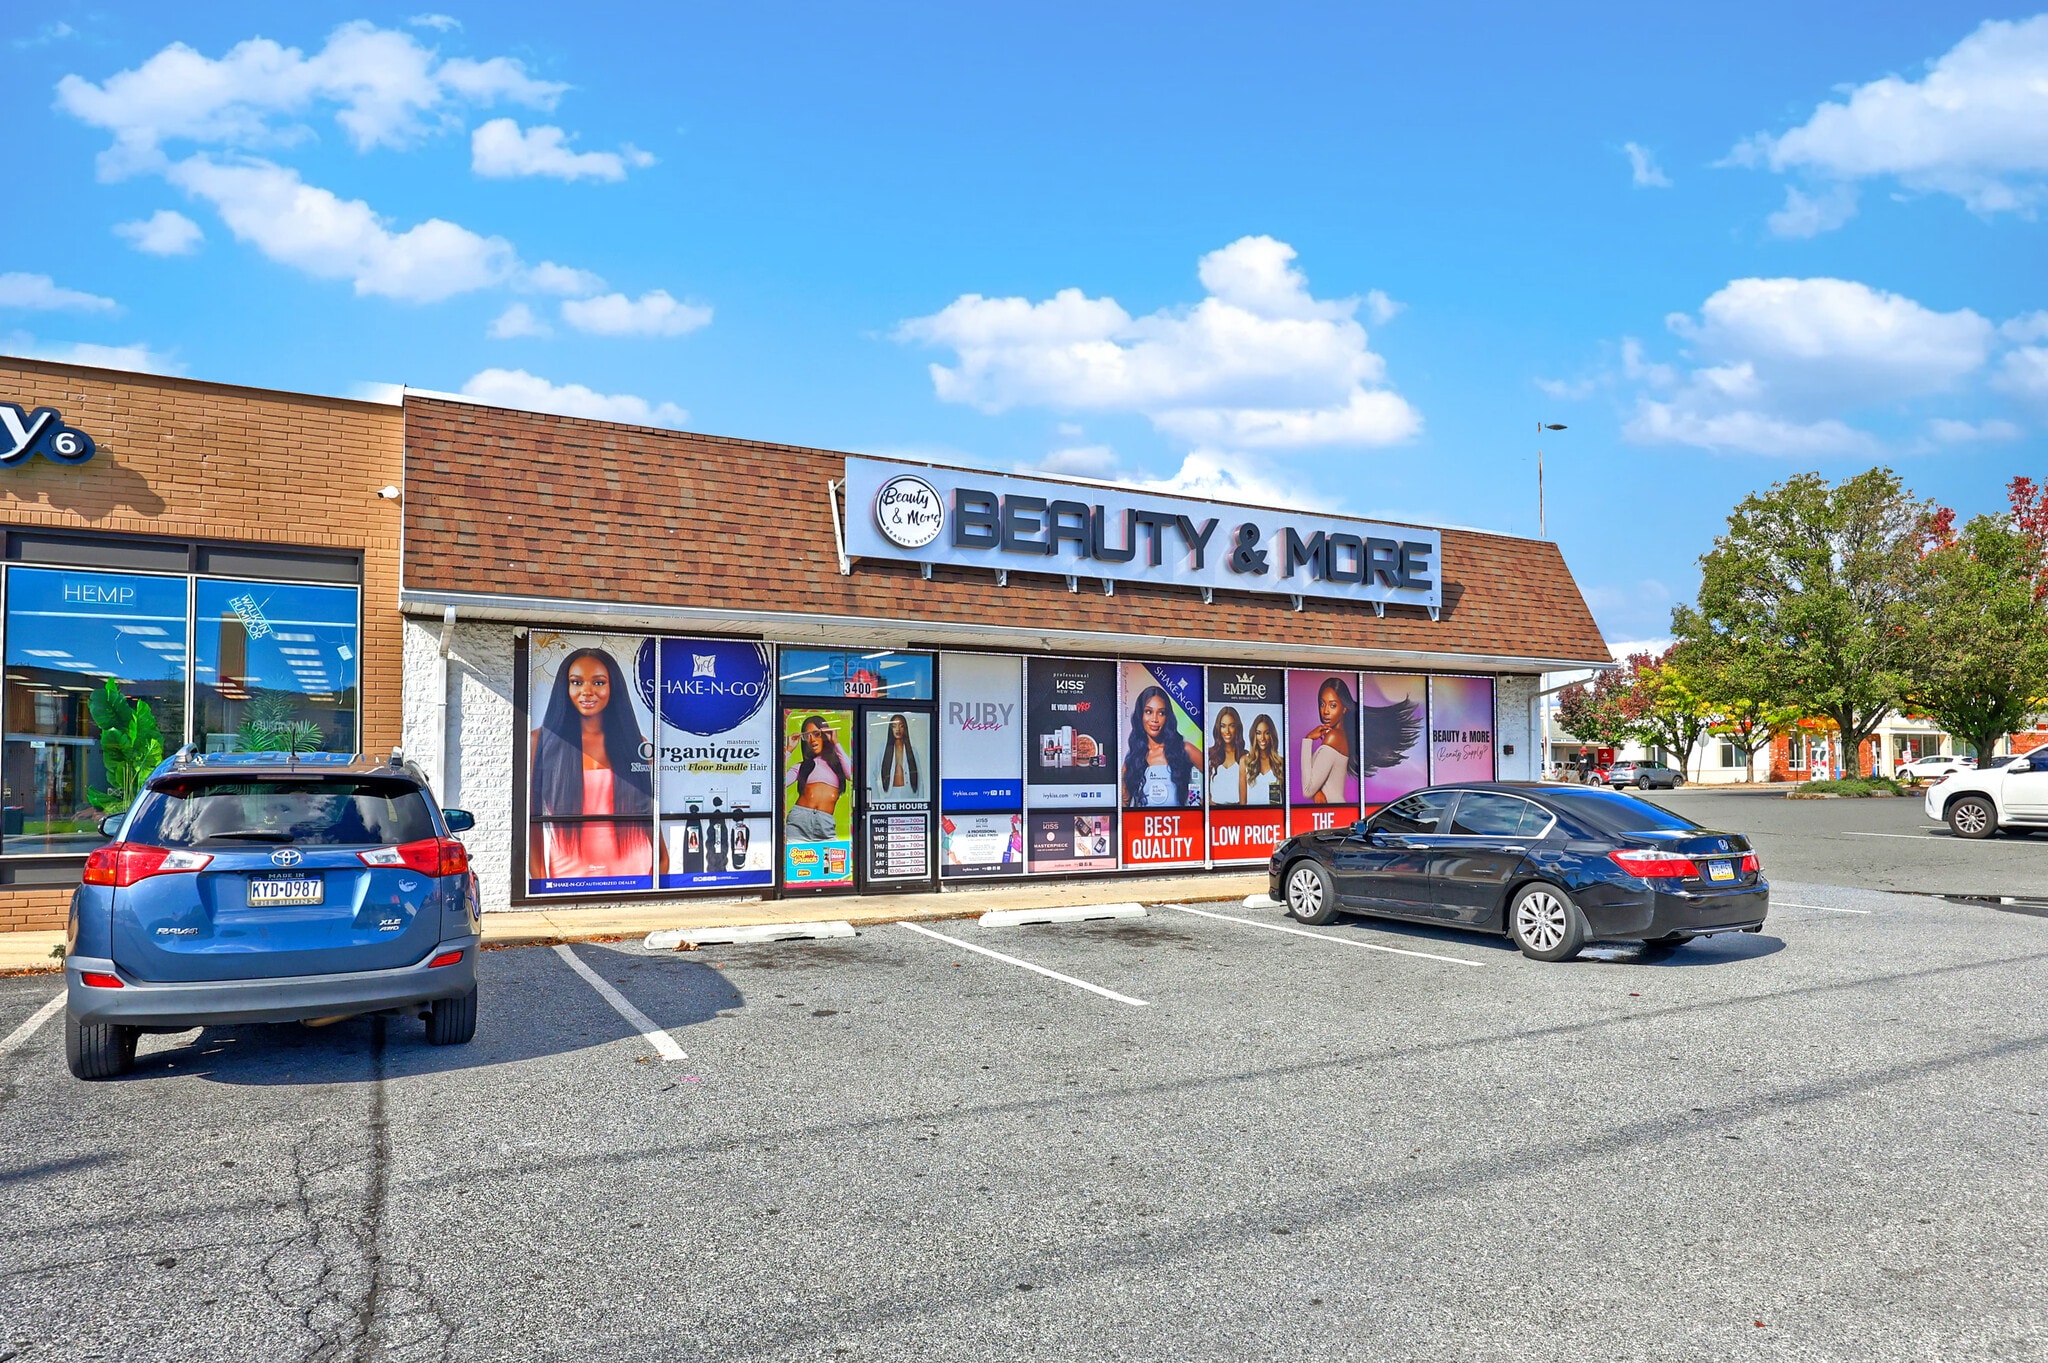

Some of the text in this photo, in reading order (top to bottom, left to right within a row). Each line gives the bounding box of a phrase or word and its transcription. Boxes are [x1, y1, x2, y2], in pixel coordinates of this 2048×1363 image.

[56, 433, 76, 454] 6
[883, 487, 928, 509] Beauty
[892, 507, 939, 526] & More
[886, 526, 937, 544] BEAUTY SUPPLY
[951, 487, 1433, 591] BEAUTY & MORE
[64, 583, 134, 603] HEMP
[230, 596, 263, 640] HUMIDOR
[241, 594, 271, 635] WALK-IN
[646, 678, 759, 697] SHAKE-N-GO
[845, 682, 871, 695] 3400
[1056, 679, 1085, 690] KISS
[1154, 666, 1198, 716] SHAKE-N-GO
[949, 701, 1015, 726] RUBY
[962, 717, 1003, 731] Kisses
[1433, 730, 1490, 743] BEAUTY & MORE
[637, 742, 758, 763] Organique
[1437, 746, 1461, 762] Beauty
[630, 762, 768, 773] New oncept Floor Bundle Hair
[870, 803, 897, 811] STORE
[1144, 815, 1181, 837] BEST
[1312, 812, 1335, 831] THE
[1211, 824, 1281, 846] LOW PRICE
[1132, 837, 1193, 860] QUALITY
[379, 918, 402, 926] XLE
